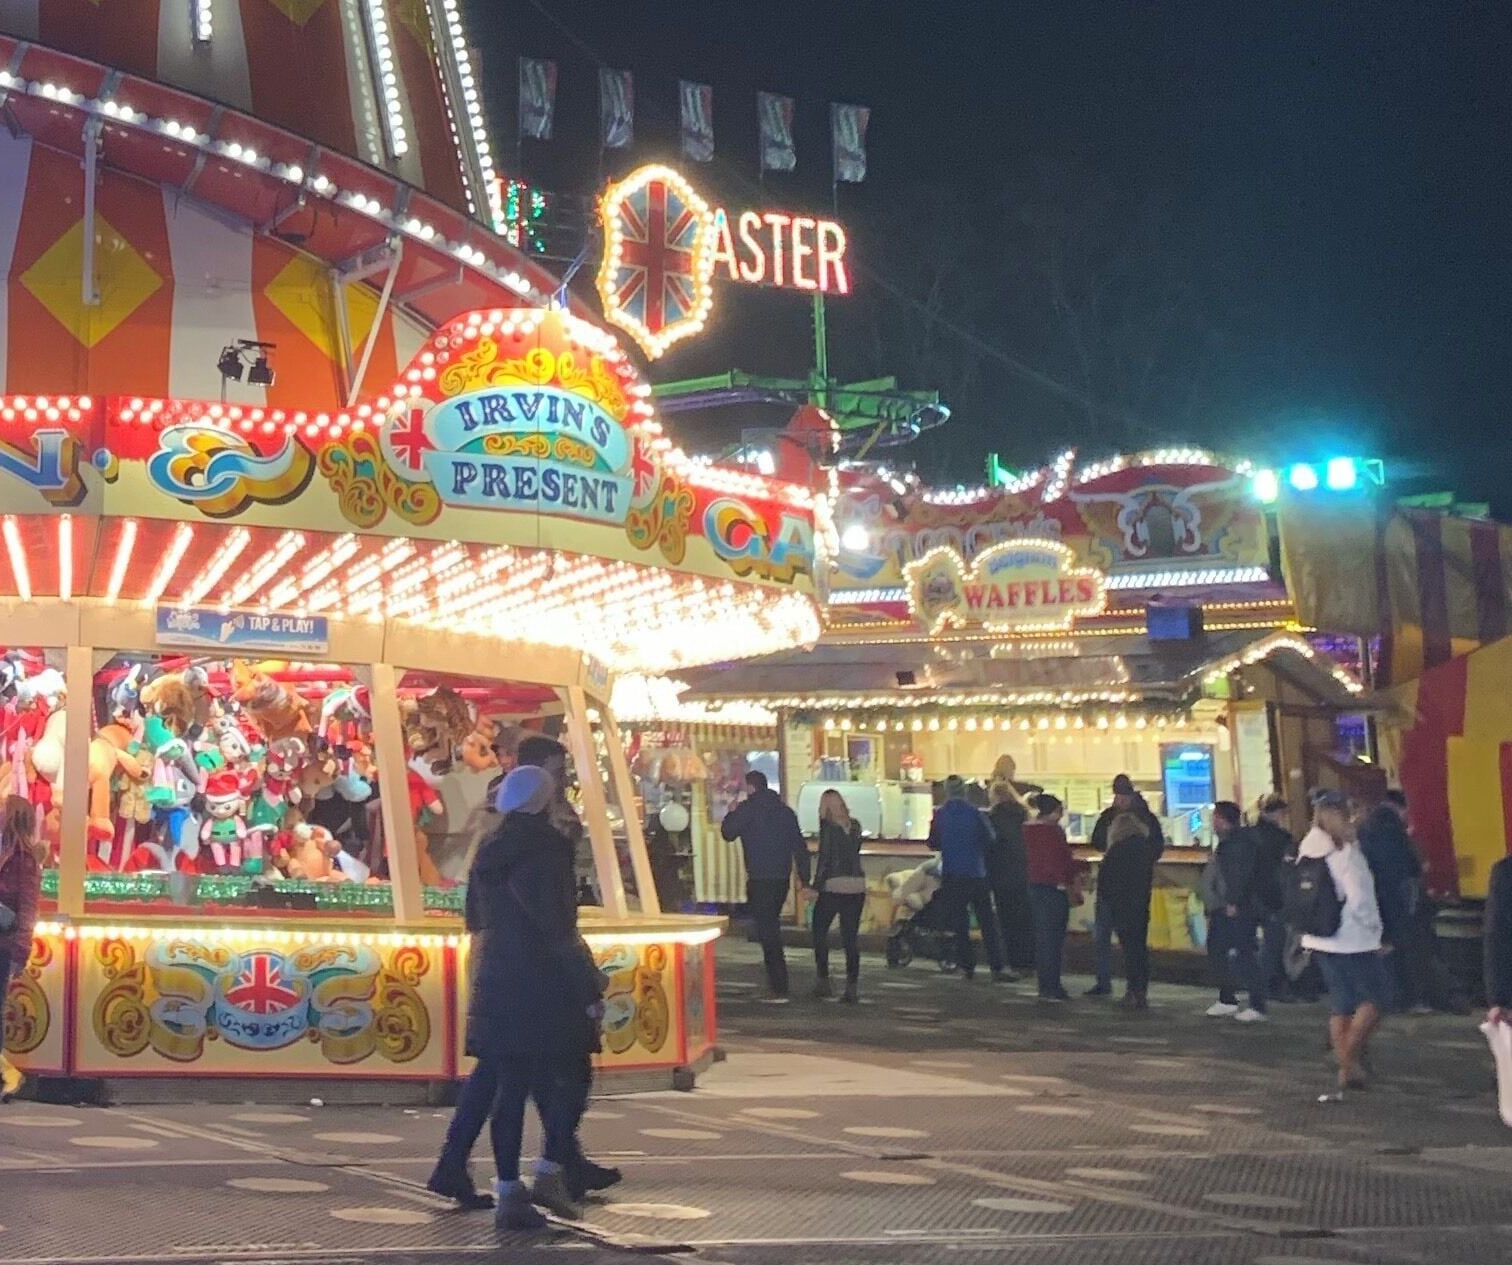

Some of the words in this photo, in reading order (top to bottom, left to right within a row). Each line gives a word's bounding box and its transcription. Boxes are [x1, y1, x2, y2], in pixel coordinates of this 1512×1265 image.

[453, 391, 612, 449] IRVIN'S
[450, 460, 619, 514] PRESENT
[963, 578, 1094, 608] WAFFLES
[248, 616, 270, 632] TAP
[271, 617, 281, 633] &
[282, 617, 315, 635] PLAY!
